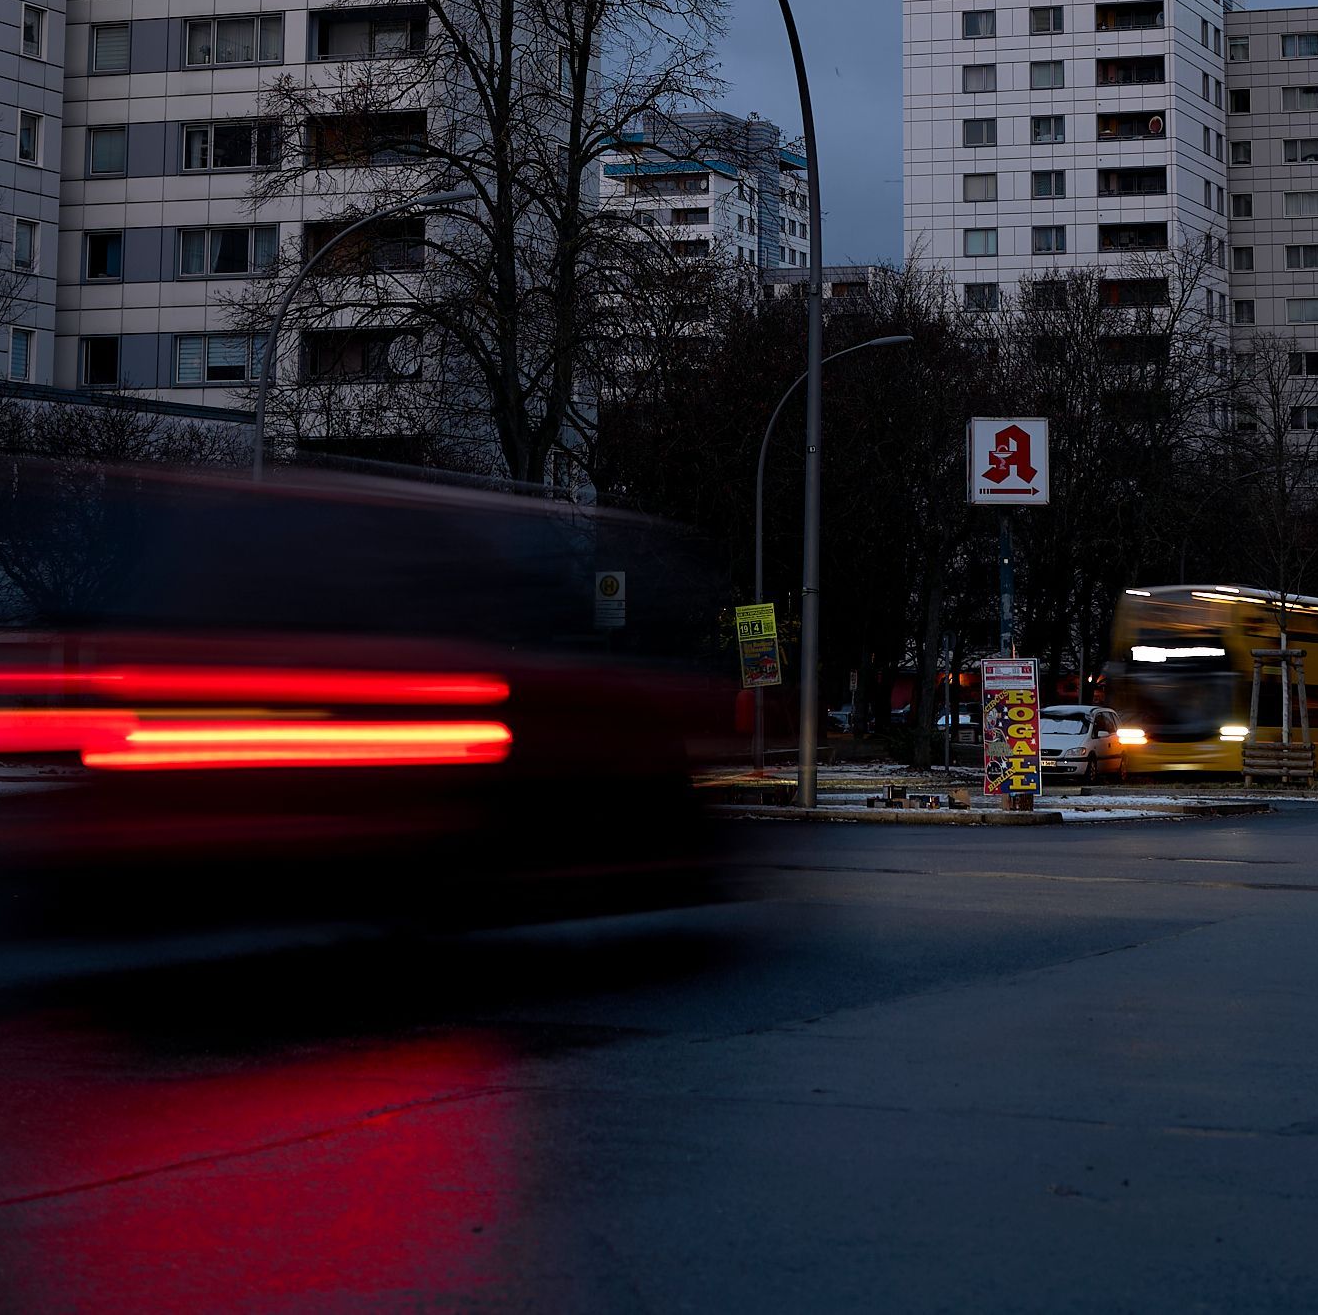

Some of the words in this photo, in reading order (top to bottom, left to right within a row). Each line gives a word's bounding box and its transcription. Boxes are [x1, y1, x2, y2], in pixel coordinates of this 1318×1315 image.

[740, 625, 748, 633] 19
[754, 624, 759, 632] 4
[985, 690, 1009, 713] CIRCUS
[1006, 689, 1036, 790] ROGALL
[988, 766, 1017, 792] BERLIN
